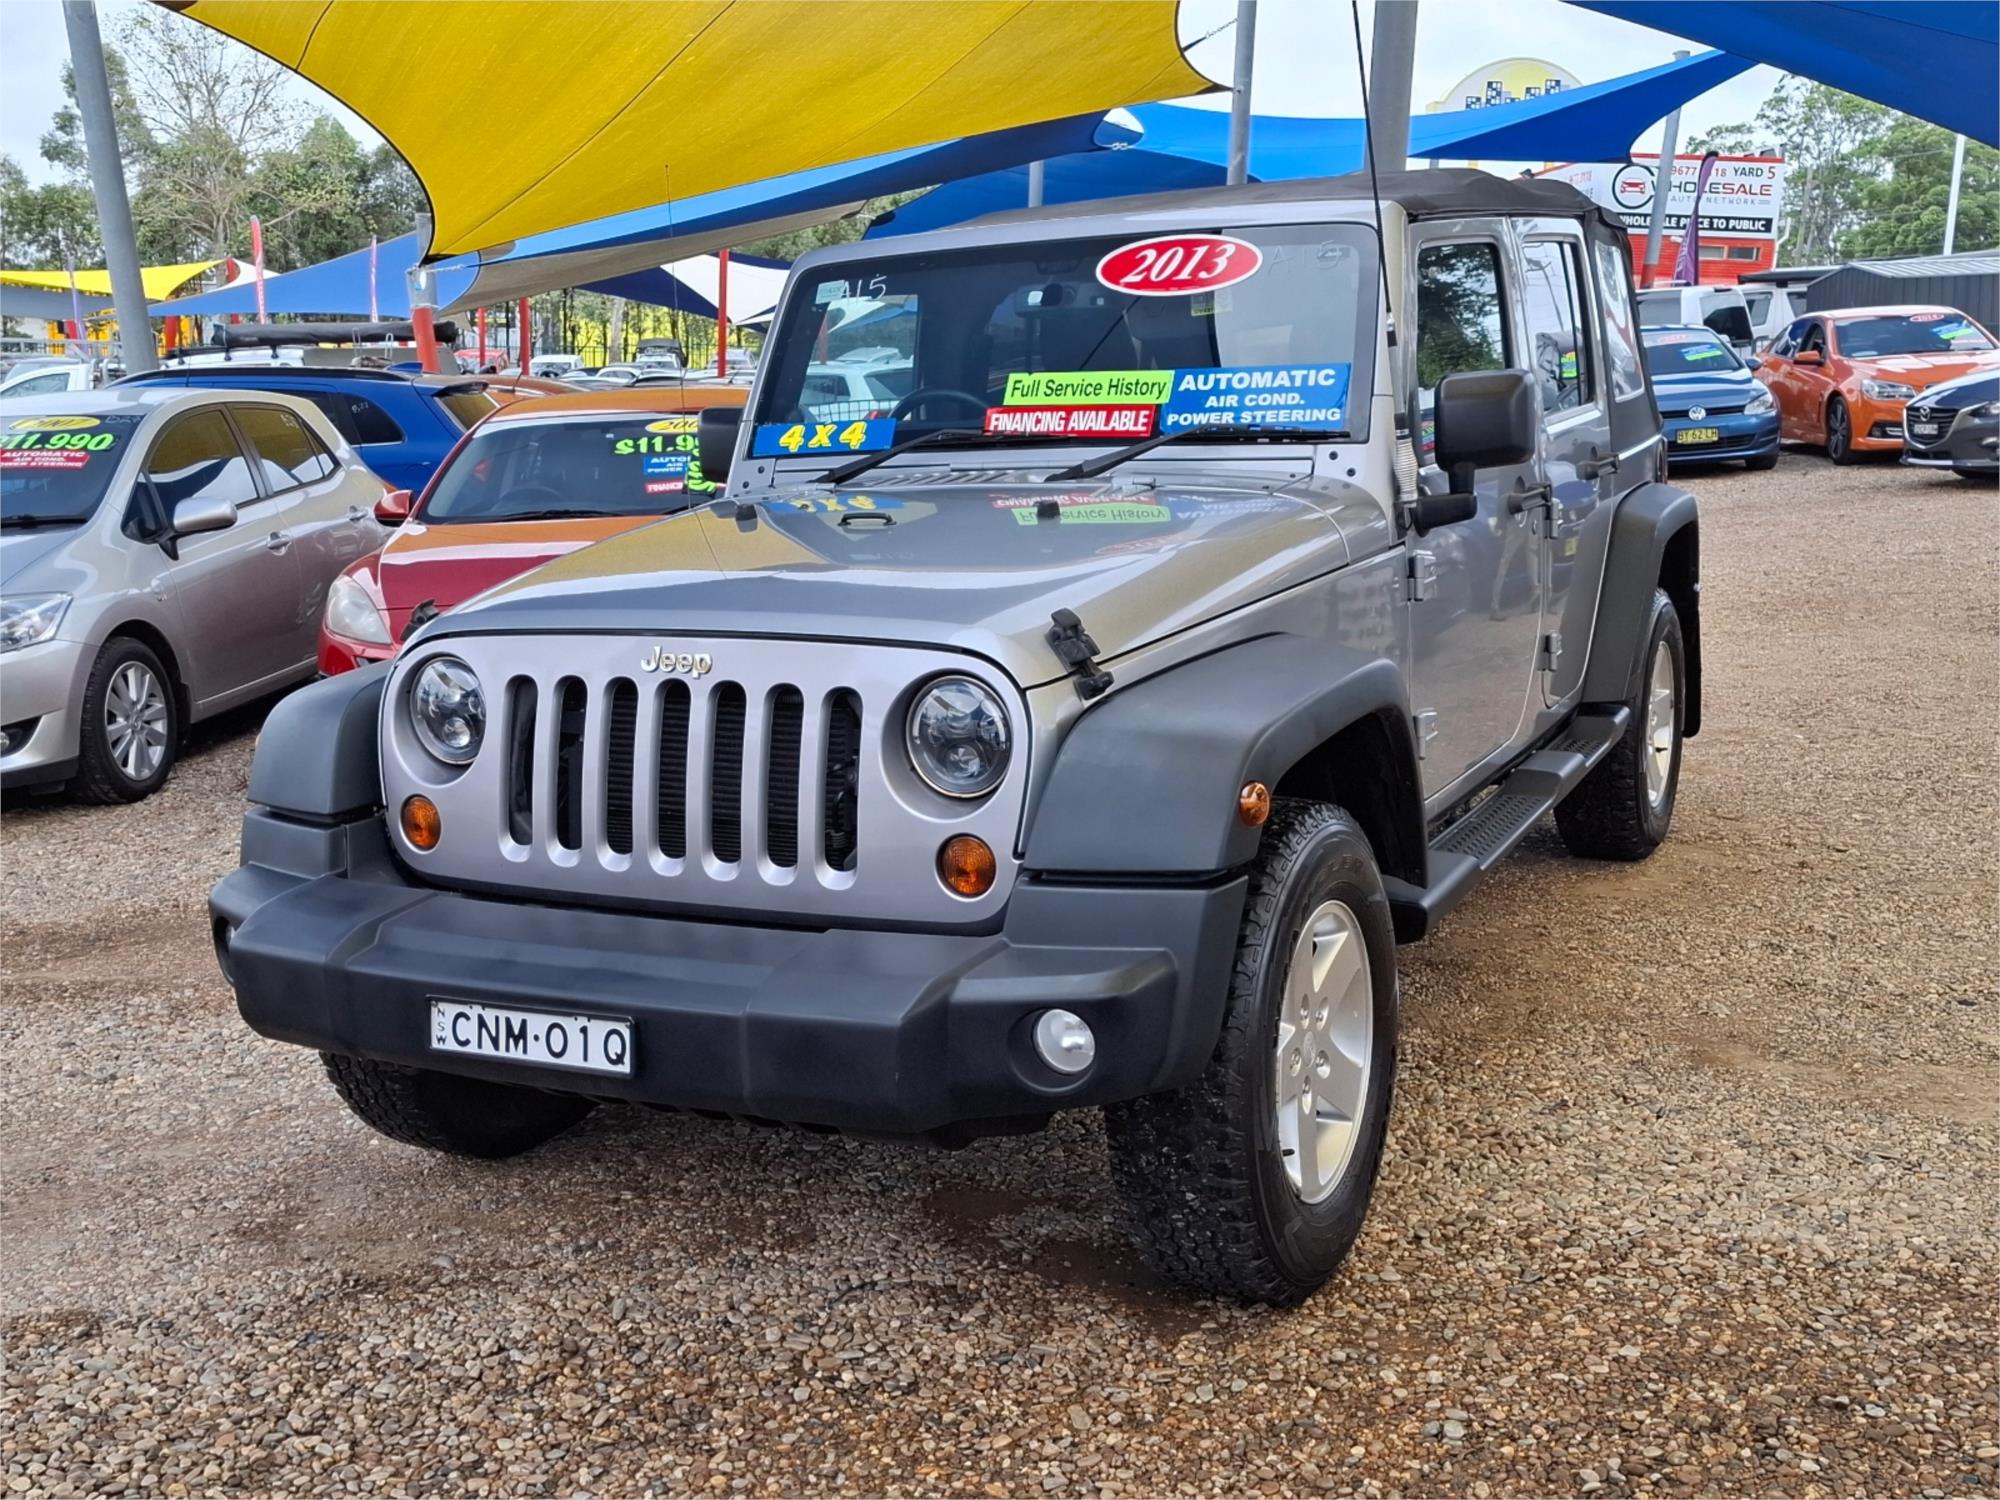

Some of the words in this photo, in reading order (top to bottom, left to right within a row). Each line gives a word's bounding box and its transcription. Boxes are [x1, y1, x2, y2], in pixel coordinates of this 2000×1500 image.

[1733, 166, 1764, 177] YARD
[1767, 166, 1777, 180] 5
[1651, 179, 1773, 196] HOESALE
[1706, 196, 1756, 206] NETWORK
[1619, 214, 1678, 228] WHOLELE
[1713, 218, 1727, 230] TO
[1729, 219, 1767, 231] PUBLIC
[1120, 243, 1235, 283] 2013
[1011, 378, 1040, 398] Full
[1045, 377, 1103, 397] Service
[1107, 373, 1167, 399] History
[1178, 368, 1337, 392] AUTOMATIC
[1204, 394, 1240, 408] AIR
[1244, 392, 1306, 407] COND.
[990, 411, 1065, 434] FINANCING
[1068, 409, 1150, 433] AVAILABLE
[1167, 411, 1235, 427] POWER
[1240, 408, 1342, 425] STEERING
[614, 434, 699, 456] $11.9
[651, 456, 691, 464] AUTO
[640, 645, 714, 680] Jeep
